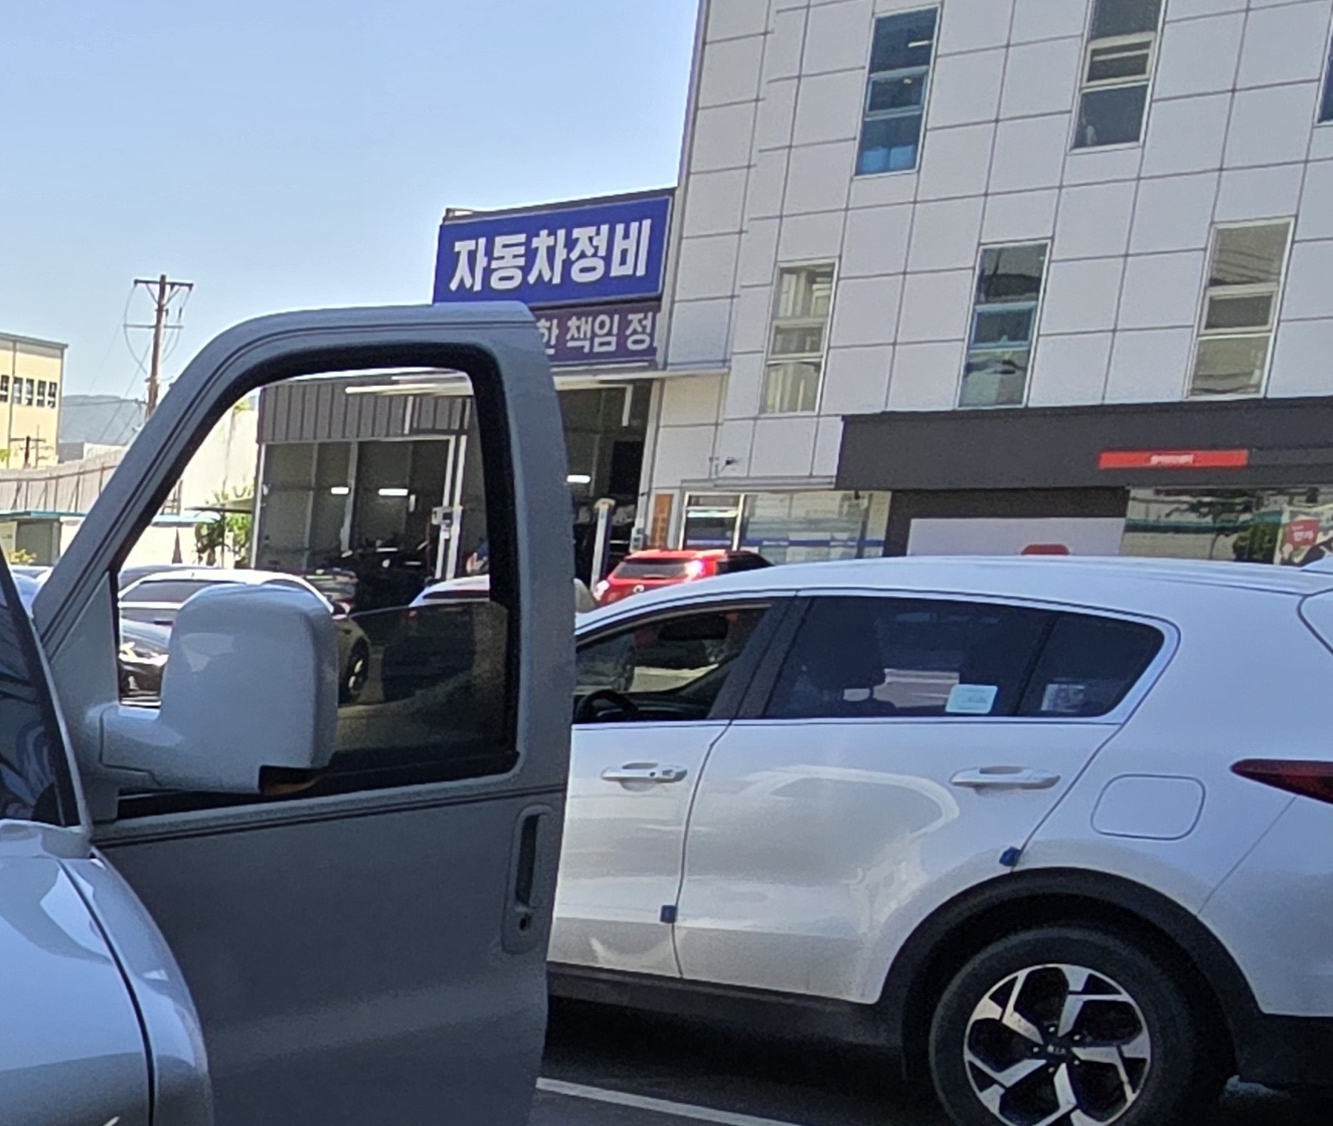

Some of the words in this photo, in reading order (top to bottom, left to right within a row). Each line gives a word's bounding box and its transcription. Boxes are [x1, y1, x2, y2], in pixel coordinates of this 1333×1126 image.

[449, 219, 652, 291] 자동차정비
[566, 314, 620, 353] 책임
[625, 312, 660, 350] 정
